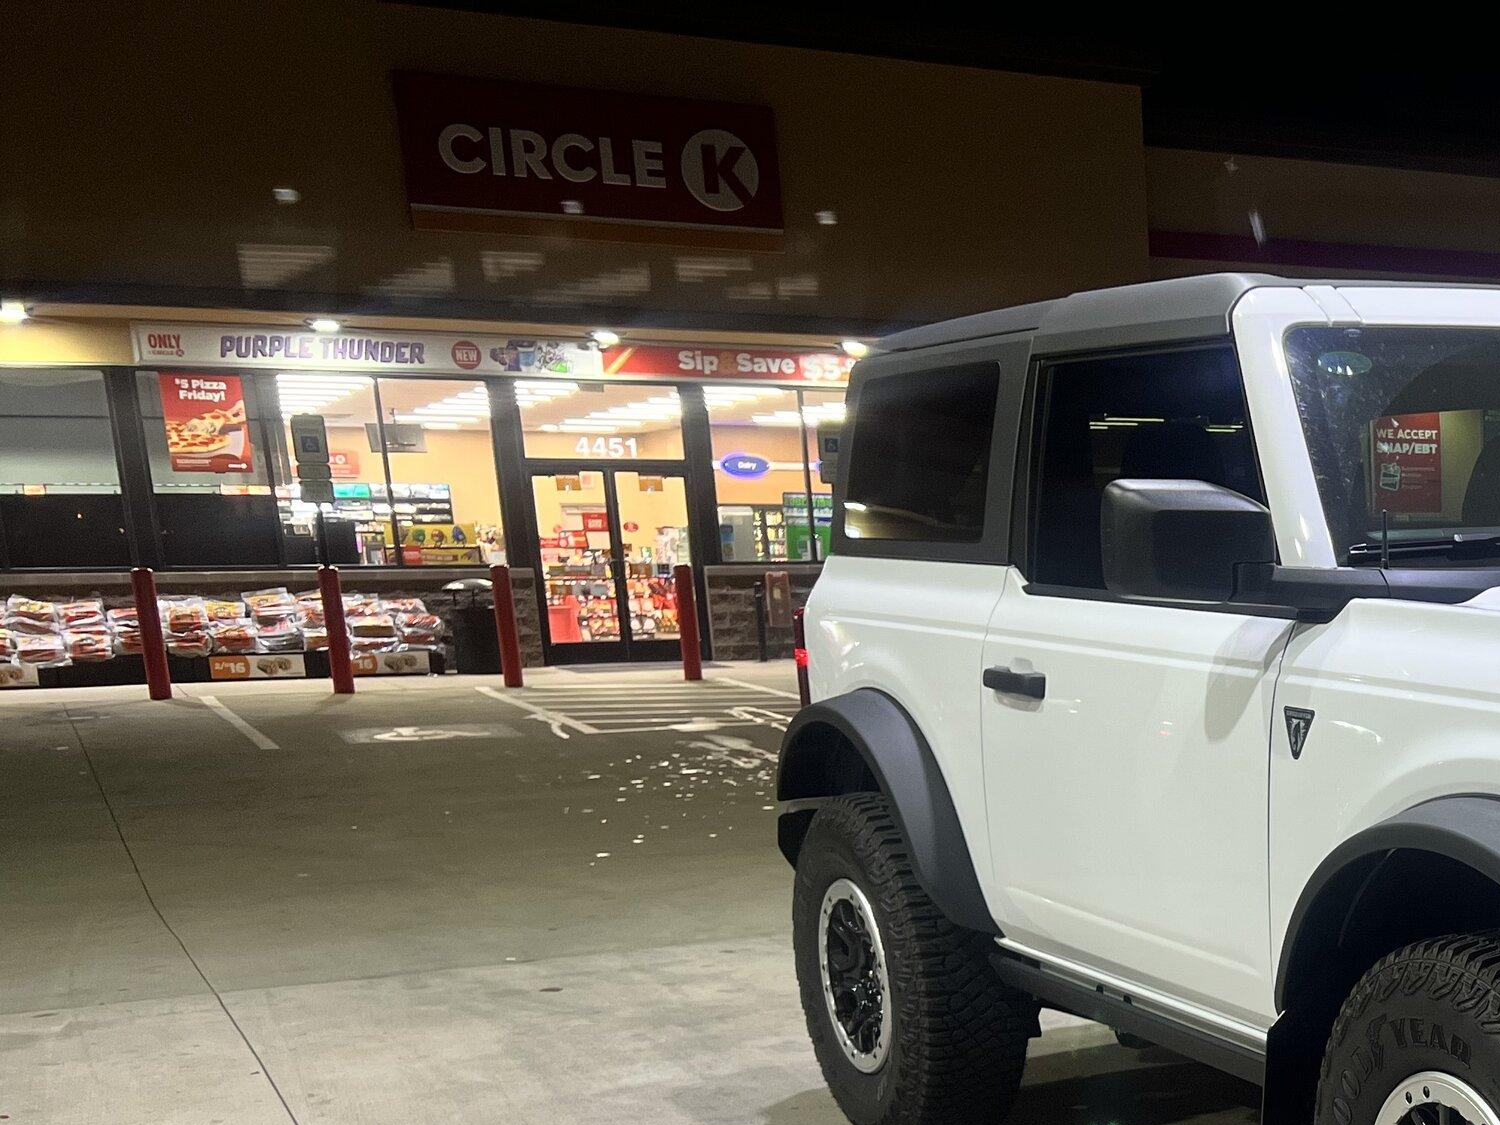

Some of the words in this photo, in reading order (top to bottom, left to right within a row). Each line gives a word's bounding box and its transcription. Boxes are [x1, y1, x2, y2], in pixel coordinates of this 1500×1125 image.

[438, 123, 667, 189] CIRCLE
[696, 140, 758, 209] K
[148, 333, 181, 349] ONLY
[220, 335, 314, 359] PURPLE
[319, 337, 426, 364] THUNDER
[455, 349, 477, 361] NEW
[678, 350, 719, 375] Sip
[736, 352, 796, 375] Save
[191, 379, 227, 390] Pizza
[1376, 429, 1394, 439] WE
[1397, 429, 1439, 440] ACCEPT
[575, 436, 638, 459] 4451
